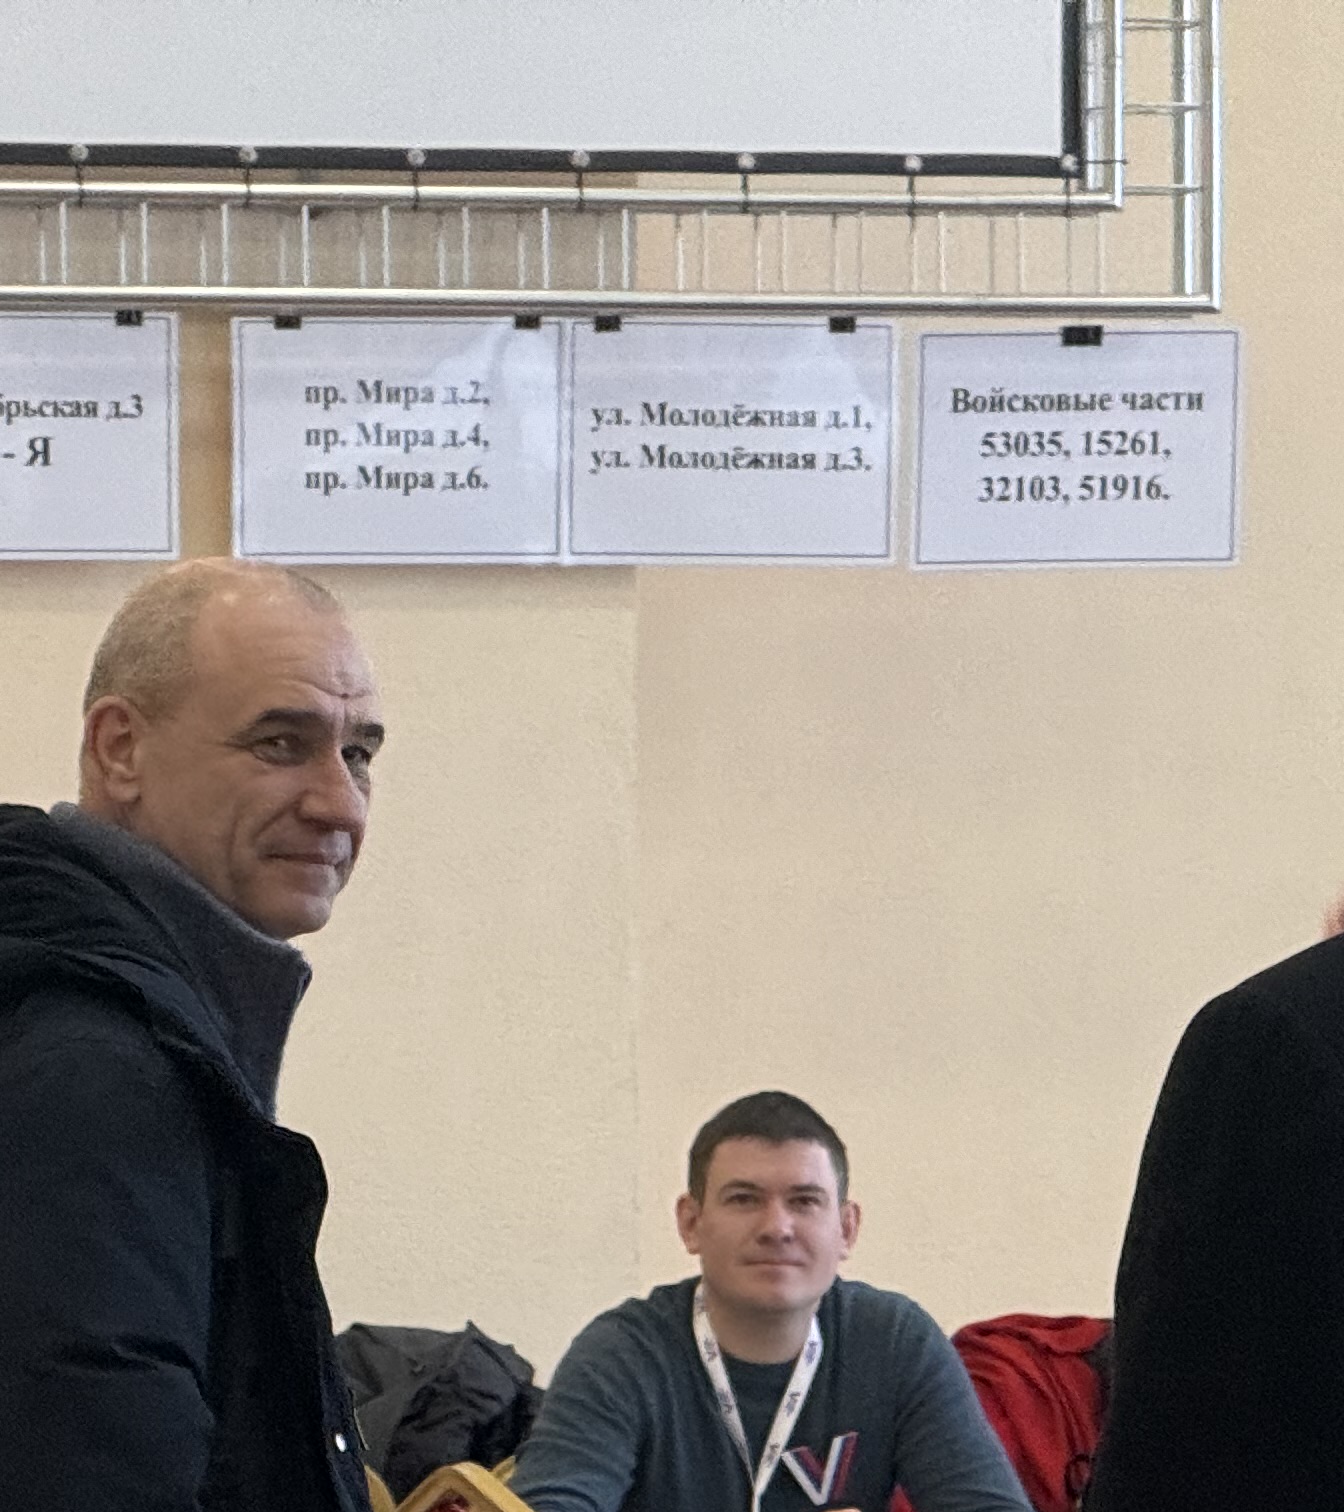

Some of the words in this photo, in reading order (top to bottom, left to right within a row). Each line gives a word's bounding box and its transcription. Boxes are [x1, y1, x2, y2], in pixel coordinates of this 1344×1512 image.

[305, 386, 347, 411] пр.
[356, 380, 434, 411] Мира
[951, 386, 1113, 413] Войсковые
[1121, 391, 1205, 412] части
[590, 408, 632, 432] ул.
[640, 401, 817, 430] Молодёжная
[25, 436, 54, 467] Я
[305, 428, 347, 453] пр.
[356, 422, 434, 453] Мира
[979, 431, 1072, 459] 53035,
[1081, 429, 1172, 459] 15261,
[588, 450, 630, 475] ул.
[639, 443, 817, 471] Молодёжная
[305, 471, 347, 496] пр.
[356, 465, 434, 496] Мира
[977, 475, 1070, 506] 32103,
[1077, 473, 1172, 502] 51916.
